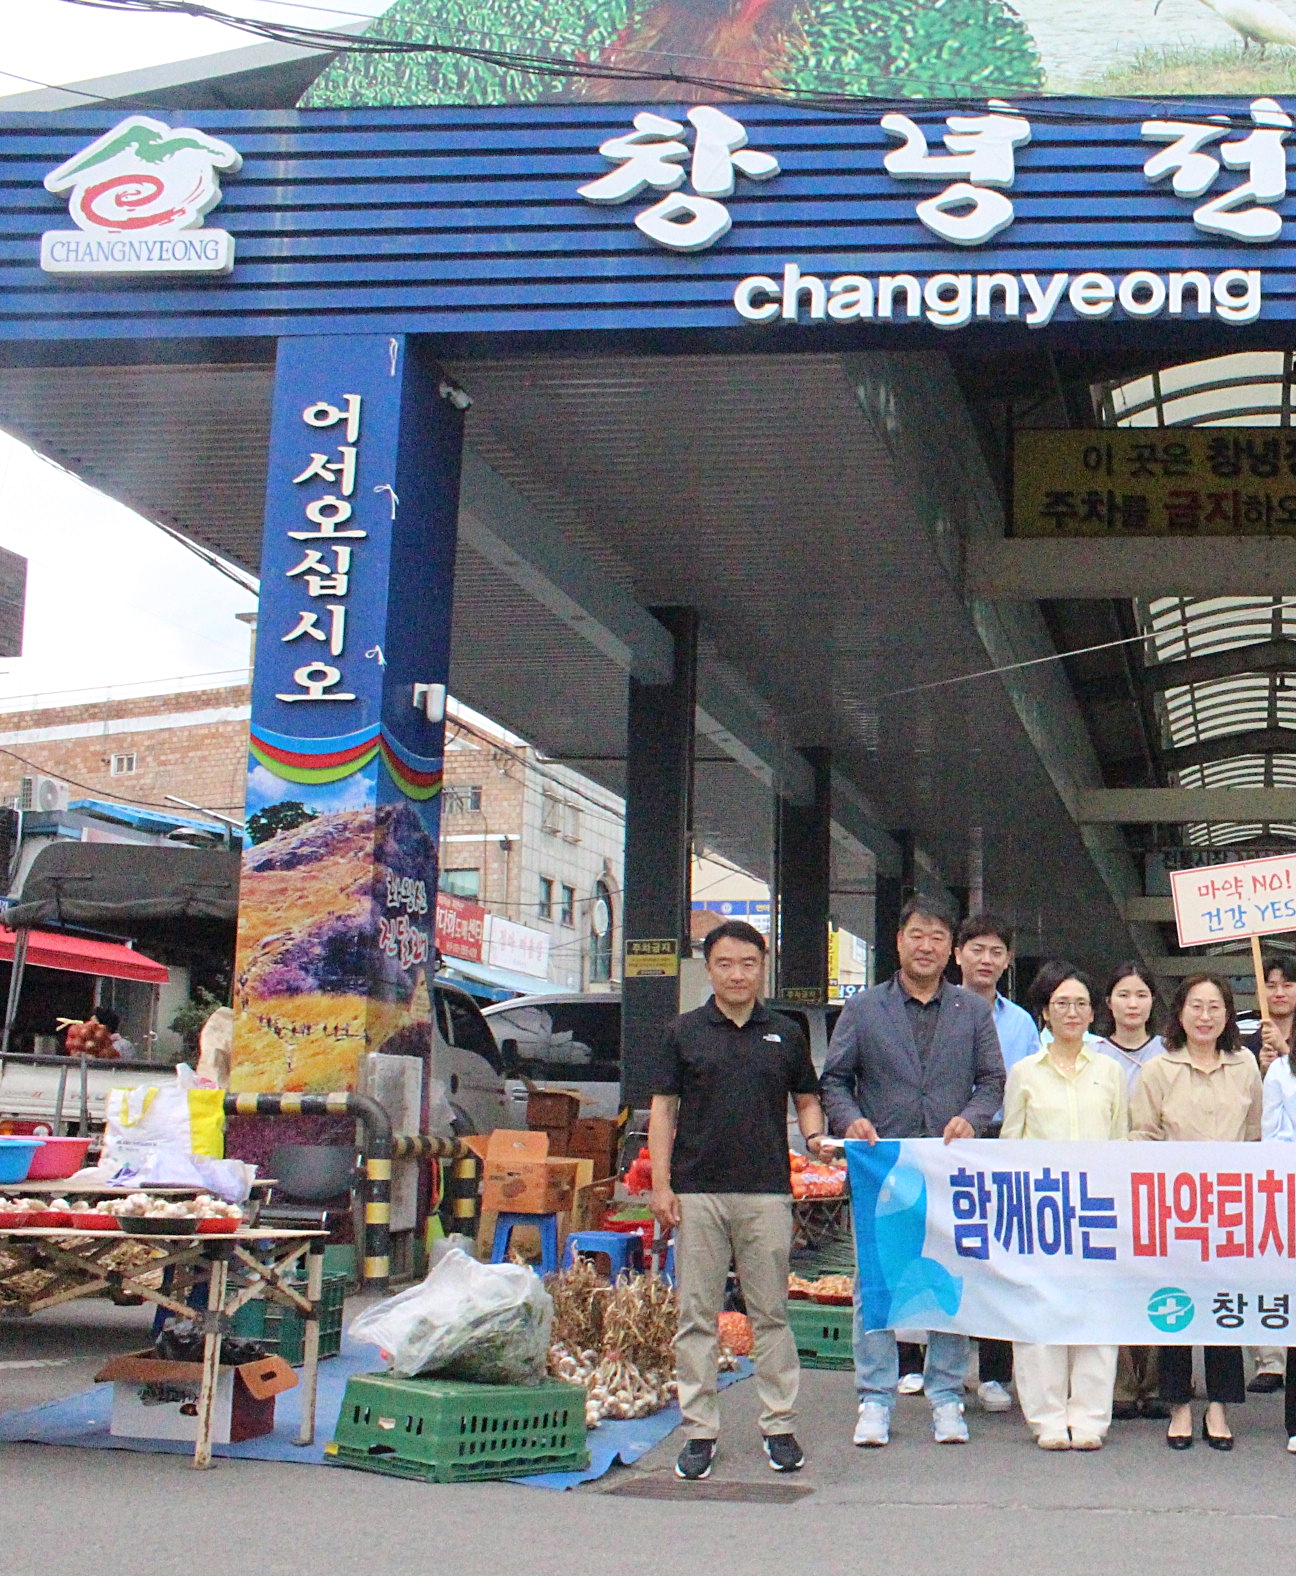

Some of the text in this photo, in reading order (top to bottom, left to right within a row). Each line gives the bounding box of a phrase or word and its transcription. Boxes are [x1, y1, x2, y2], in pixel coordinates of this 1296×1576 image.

[50, 239, 219, 263] CHANGNYEONG
[734, 262, 1262, 329] changnyeong
[1082, 444, 1114, 473] 이
[1039, 490, 1149, 531] 주차를
[275, 393, 368, 703] 어서오십시오
[1198, 869, 1292, 900] 마약 NO!
[1201, 904, 1247, 932] 건강
[949, 1166, 1118, 1261] 함께하는
[1130, 1169, 1296, 1262] 마약퇴치
